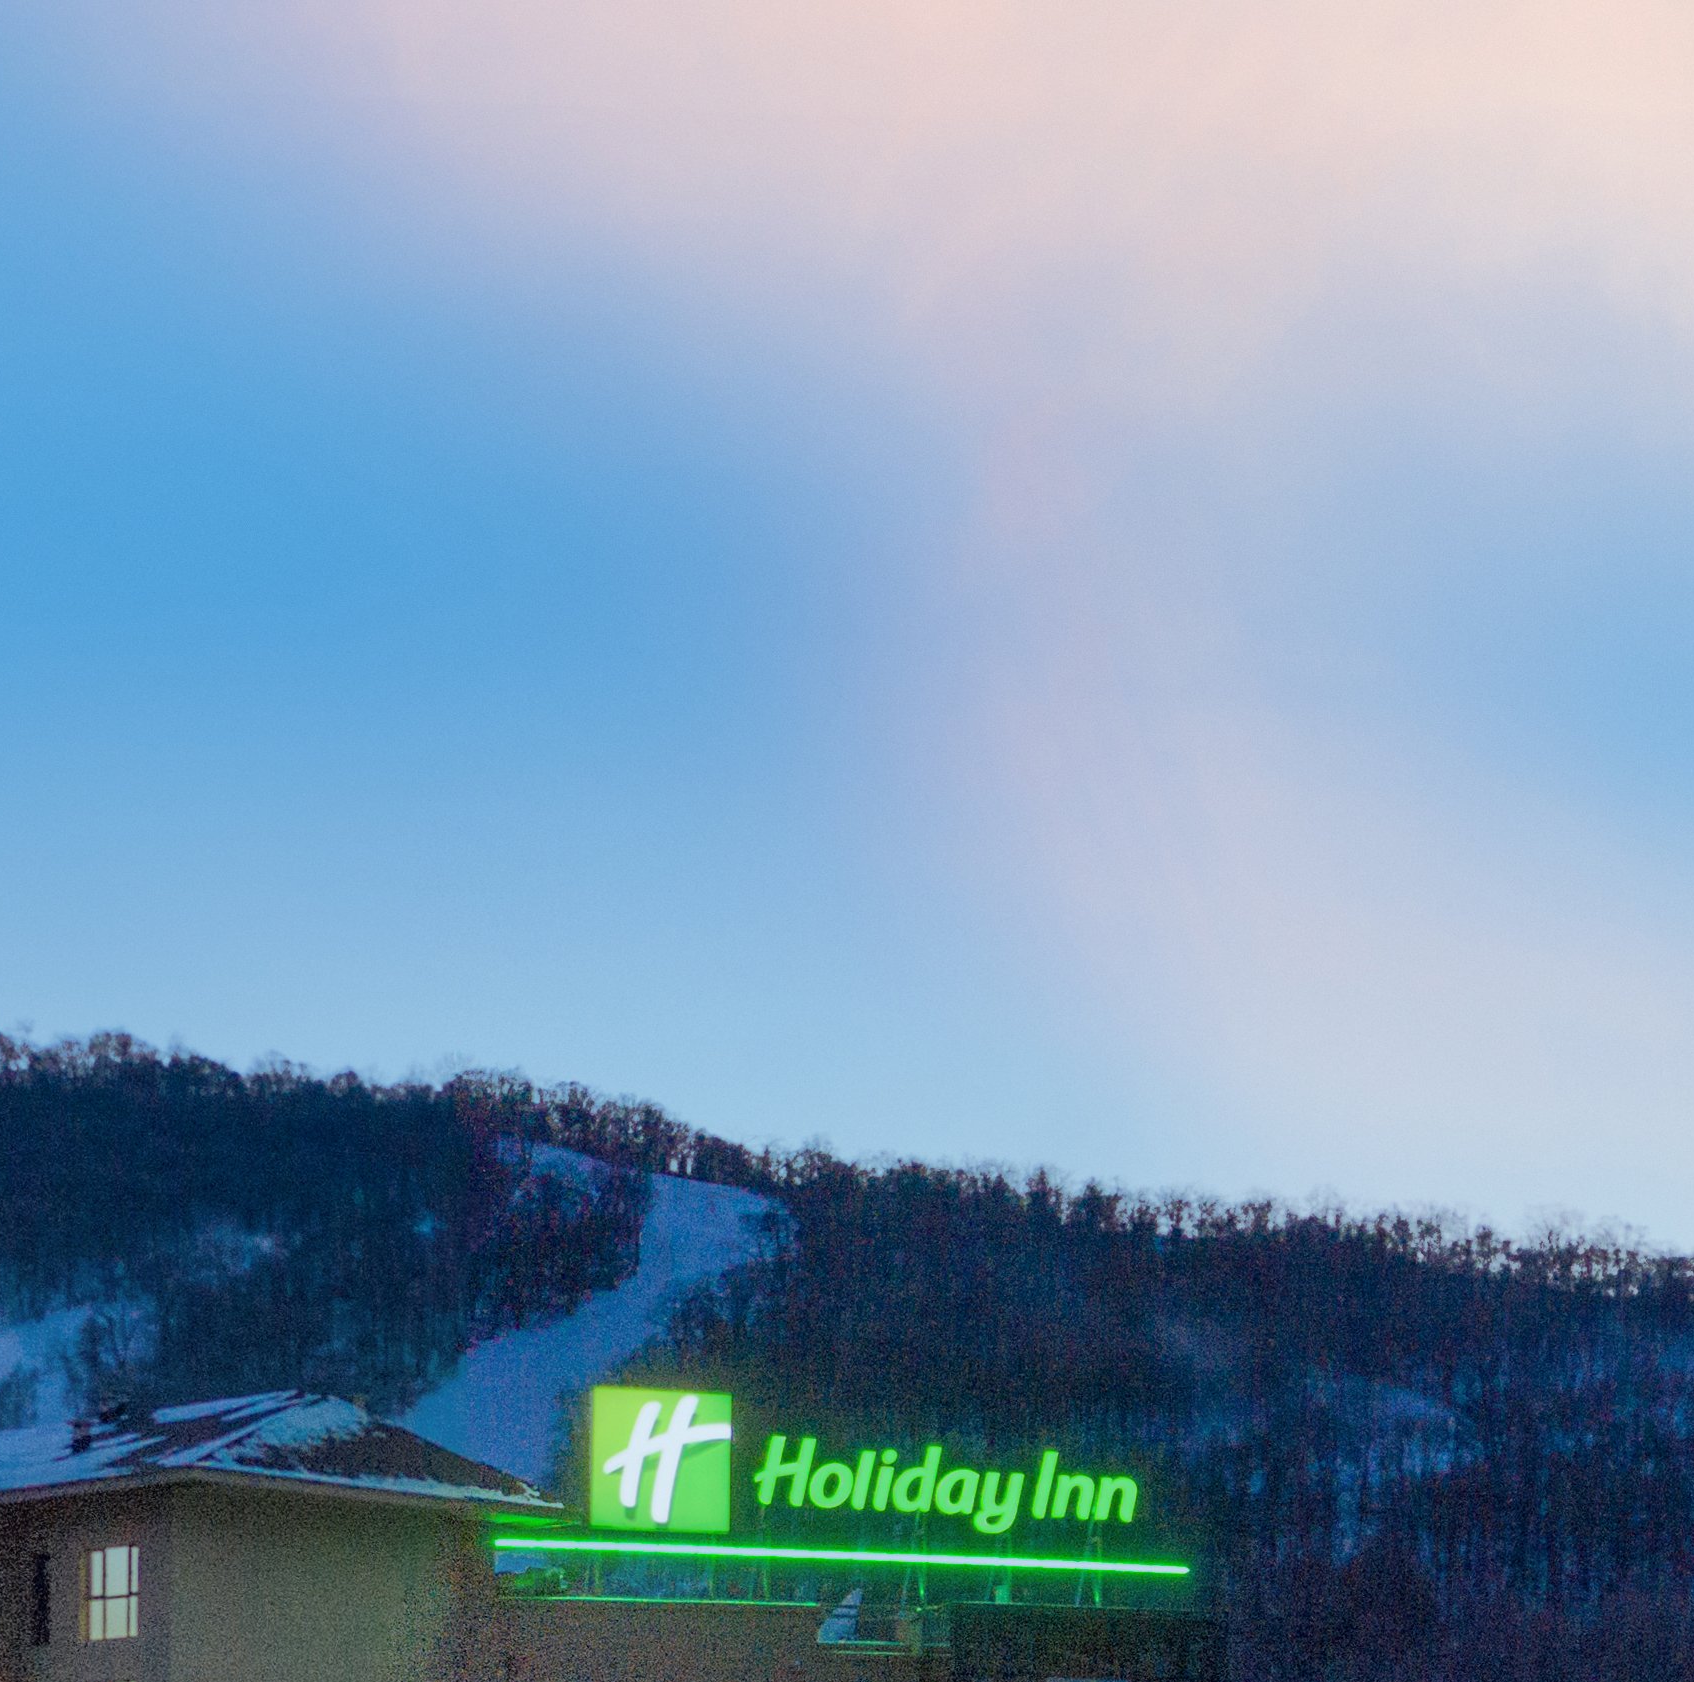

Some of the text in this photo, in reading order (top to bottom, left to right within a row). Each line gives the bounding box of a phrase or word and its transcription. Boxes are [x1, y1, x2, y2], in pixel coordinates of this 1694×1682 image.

[604, 1395, 731, 1523] H
[754, 1435, 1139, 1534] Holiday Inn
